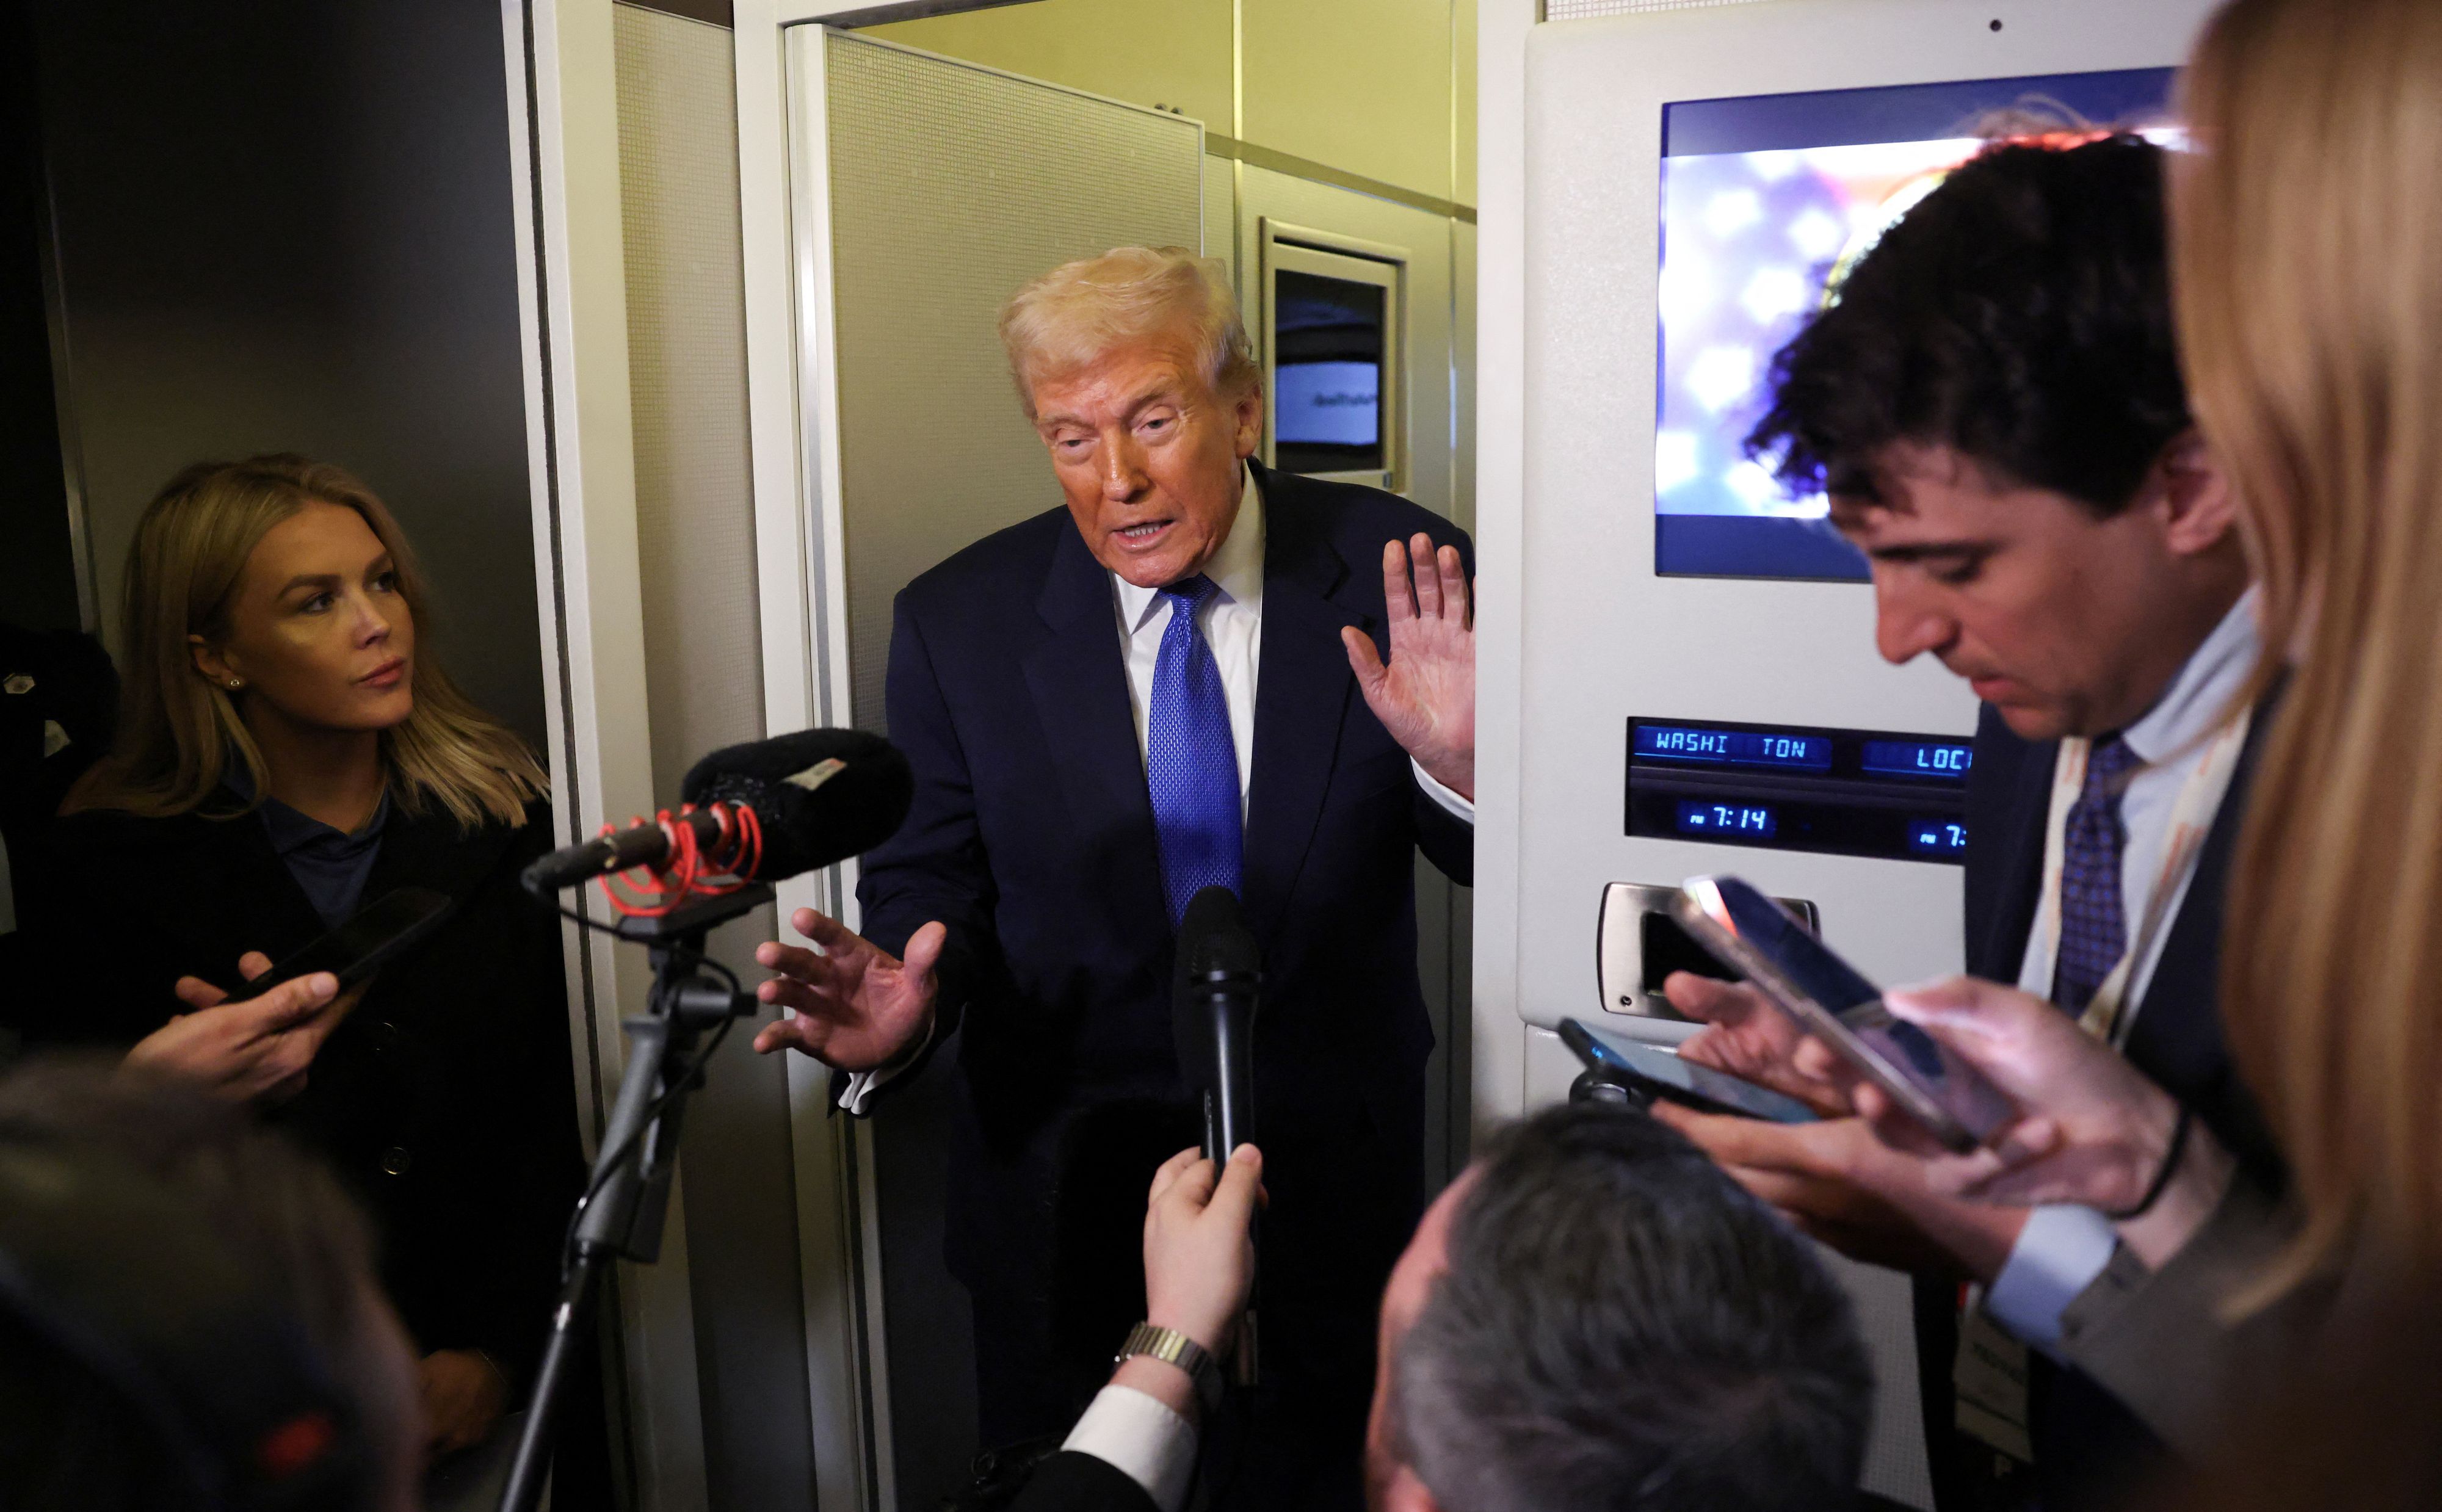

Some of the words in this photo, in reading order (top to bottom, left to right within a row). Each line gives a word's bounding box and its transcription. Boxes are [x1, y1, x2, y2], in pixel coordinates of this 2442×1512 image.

[1656, 732, 1728, 753] WASHI
[1763, 738, 1806, 758] TON
[1713, 806, 1766, 830] 7:14
